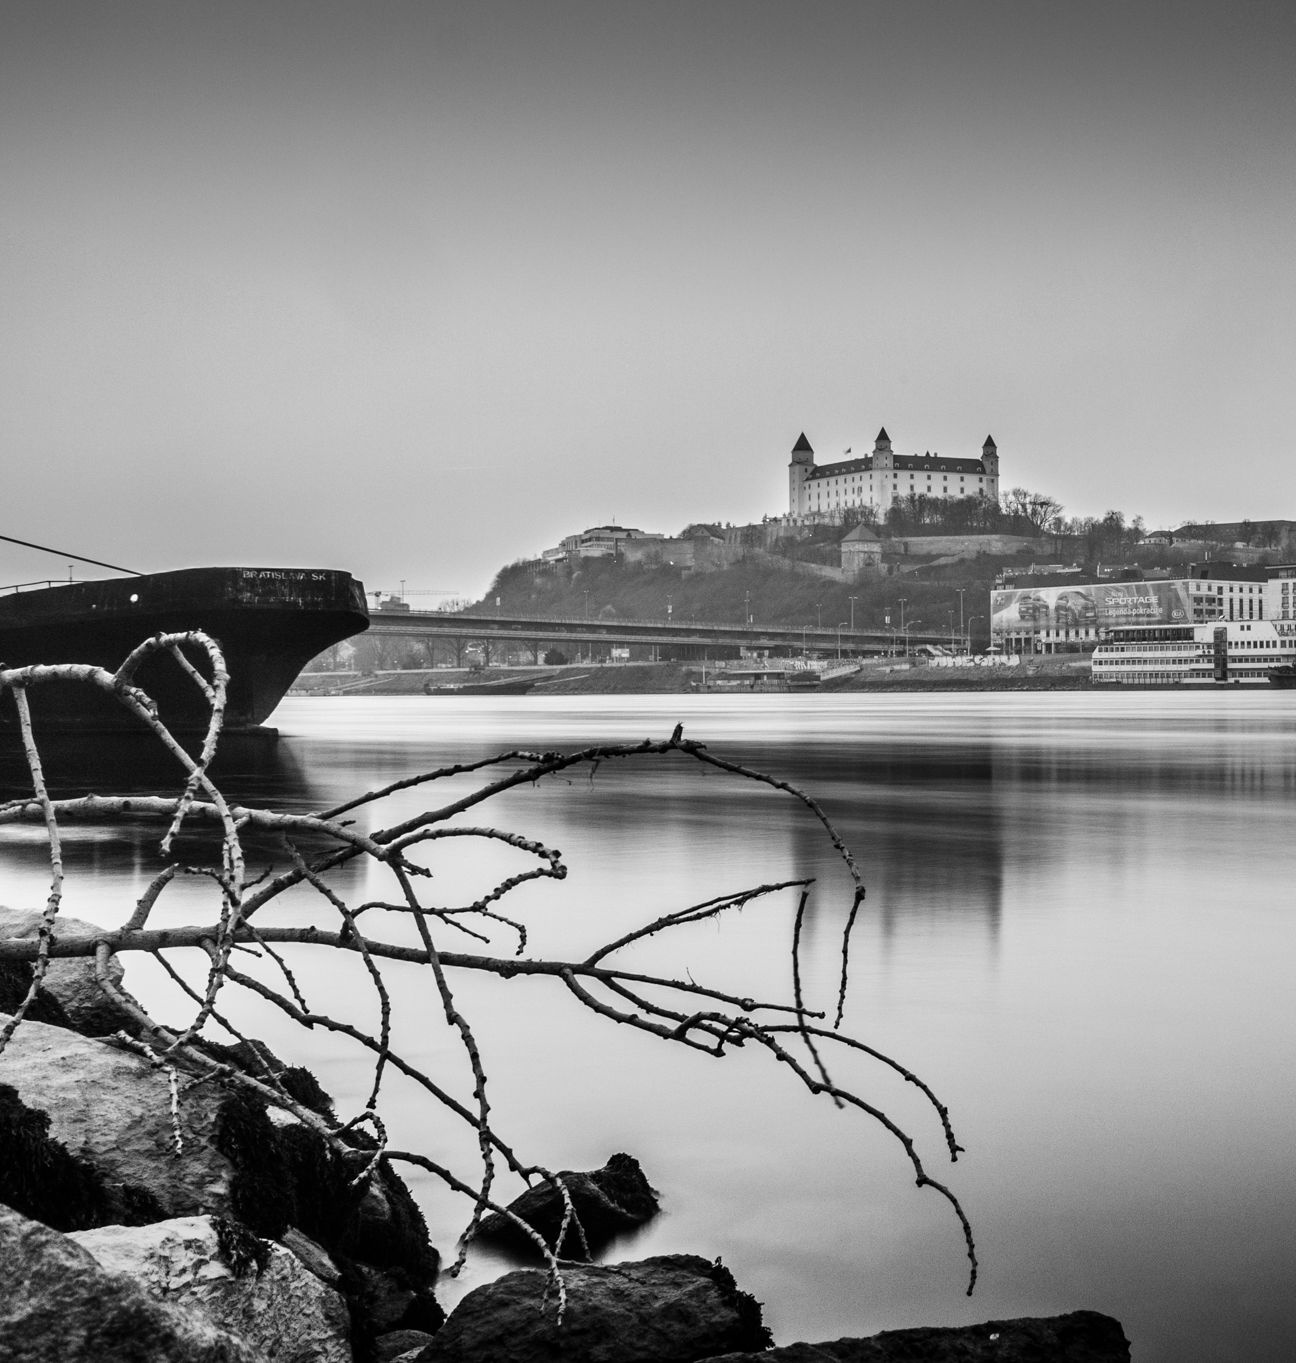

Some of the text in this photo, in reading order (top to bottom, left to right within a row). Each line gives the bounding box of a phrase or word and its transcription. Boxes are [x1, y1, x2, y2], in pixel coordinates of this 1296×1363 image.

[242, 570, 326, 581] BRATISLAVA SK
[1105, 595, 1159, 605] SPORTAGE
[1105, 607, 1131, 617] Legenda
